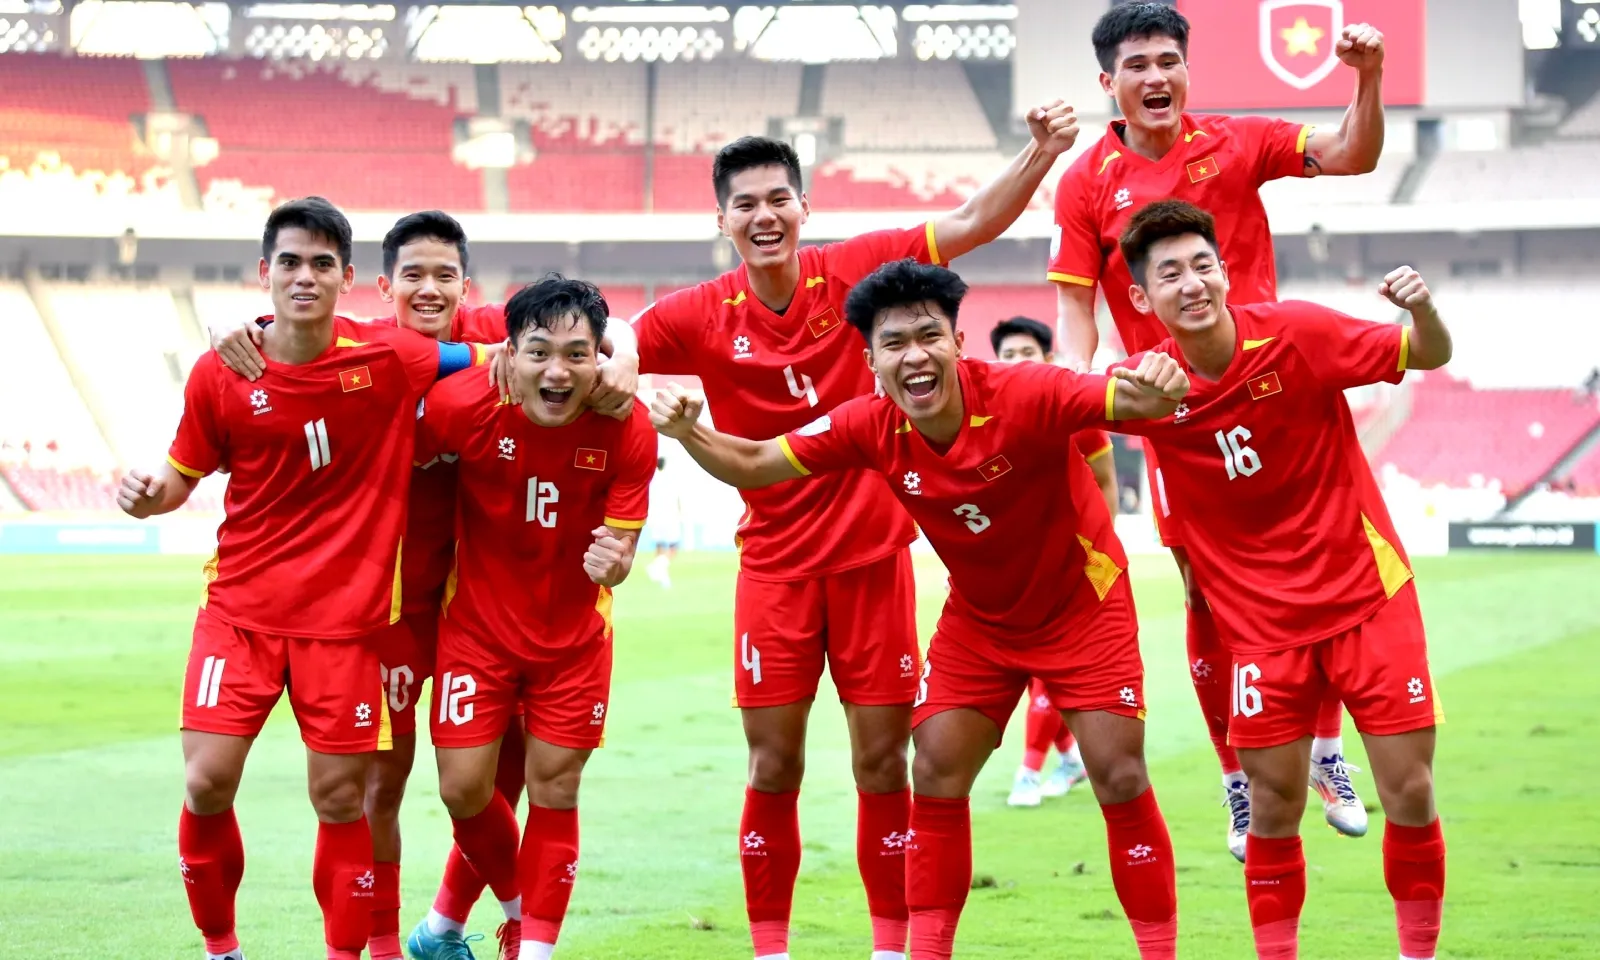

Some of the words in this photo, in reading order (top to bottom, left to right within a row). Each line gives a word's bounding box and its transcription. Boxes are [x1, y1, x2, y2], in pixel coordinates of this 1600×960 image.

[783, 365, 819, 408] 4
[304, 417, 331, 472] 11
[1215, 425, 1263, 481] 16
[526, 476, 560, 528] 12
[953, 503, 991, 535] 3
[197, 656, 226, 708] 11
[741, 631, 762, 686] 4
[439, 671, 477, 726] 12
[1233, 662, 1263, 718] 16
